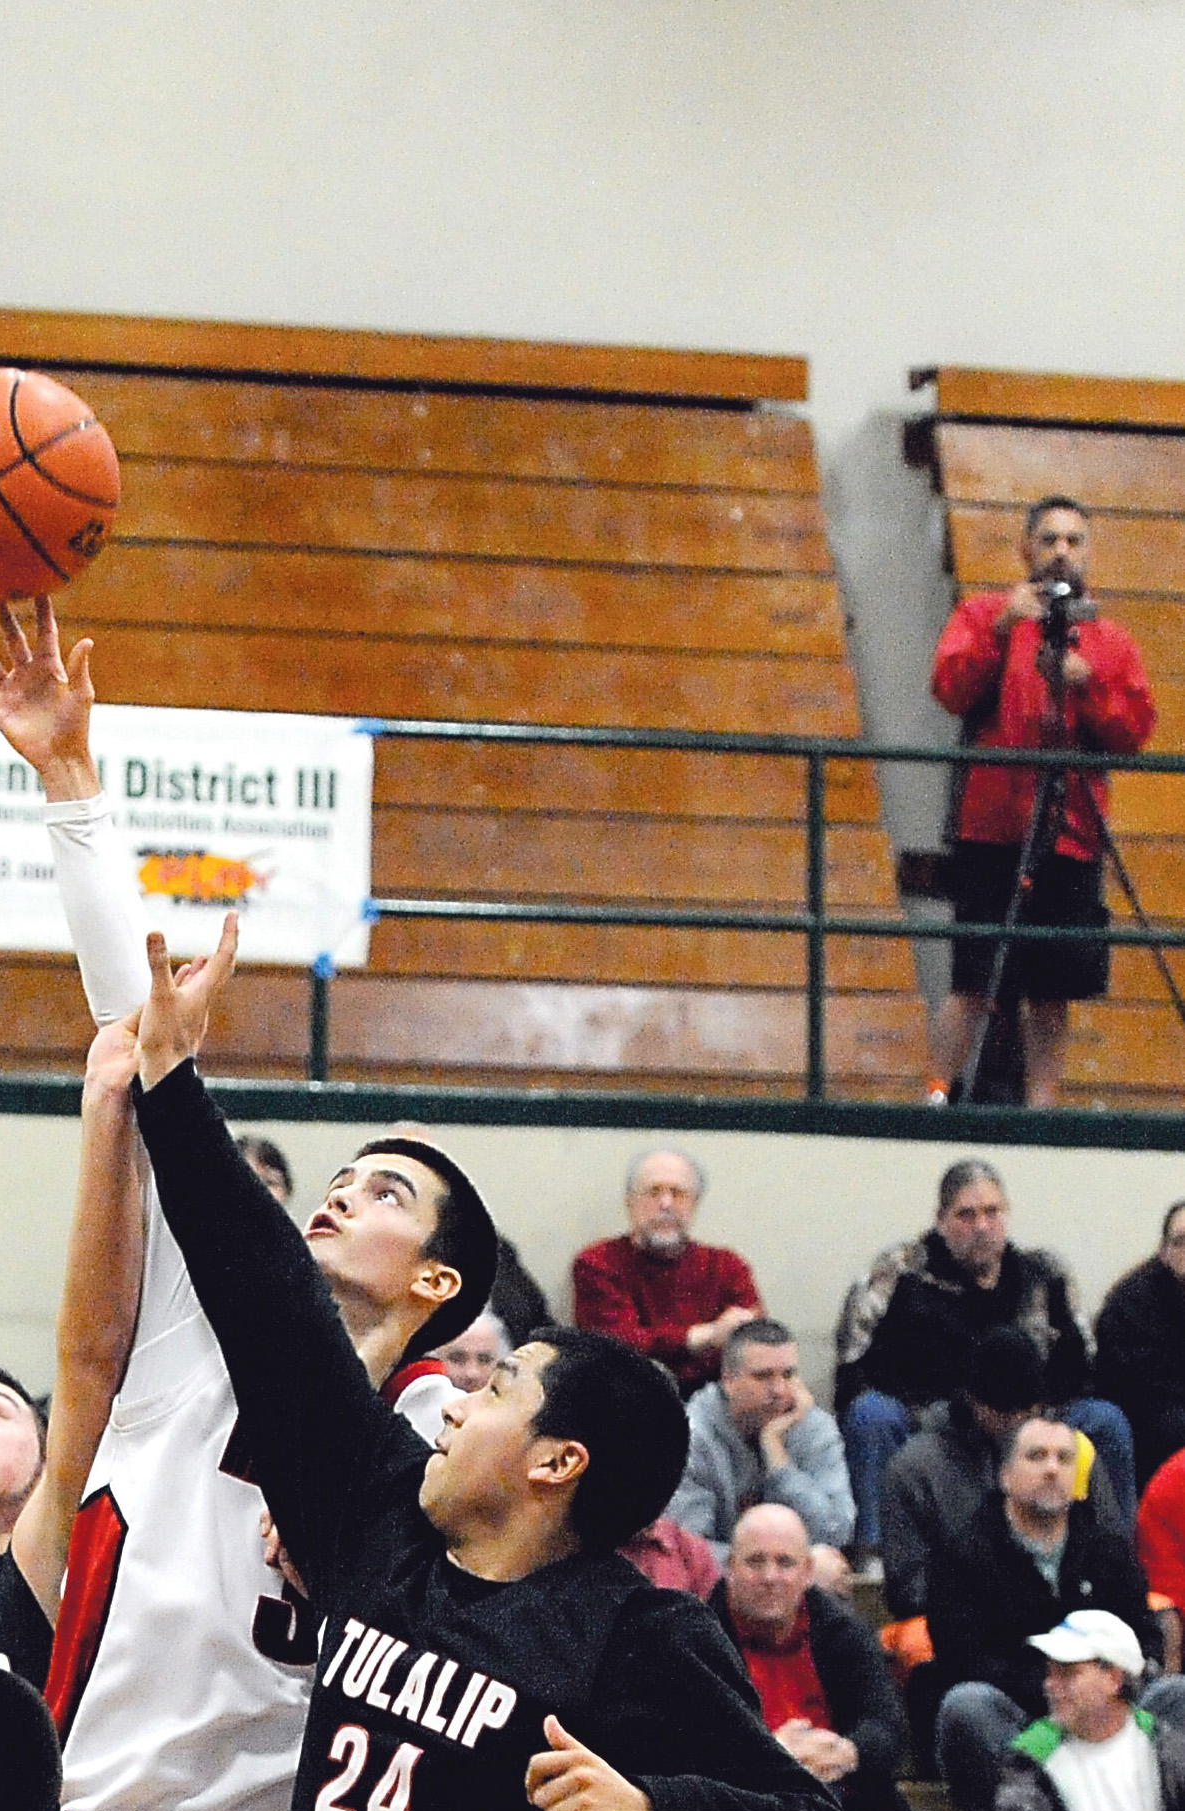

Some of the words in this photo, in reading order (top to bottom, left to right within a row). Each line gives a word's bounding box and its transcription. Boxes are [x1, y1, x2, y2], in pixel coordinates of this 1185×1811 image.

[125, 757, 277, 807] District
[296, 768, 336, 809] III
[321, 1616, 518, 1749] TULALIP
